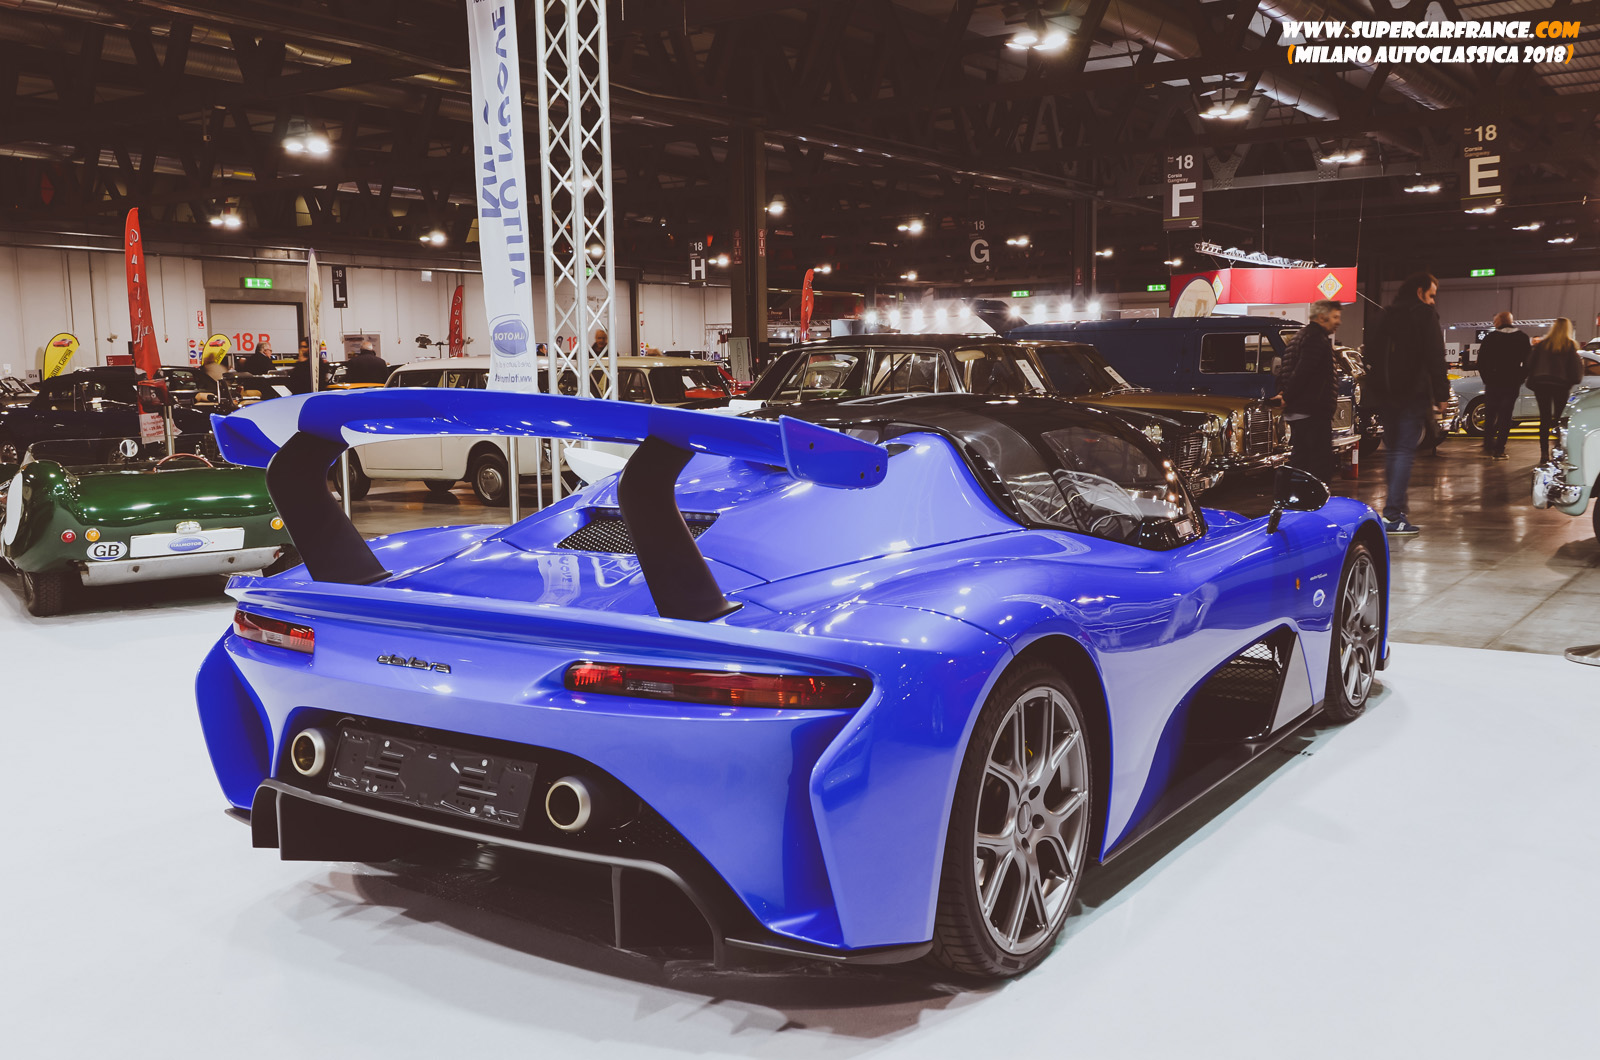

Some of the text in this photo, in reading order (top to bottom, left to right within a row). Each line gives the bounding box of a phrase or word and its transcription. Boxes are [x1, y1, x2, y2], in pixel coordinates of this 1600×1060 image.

[1474, 124, 1498, 142] 18
[1175, 154, 1194, 170] 18
[1469, 155, 1501, 196] E
[1171, 182, 1197, 218] F
[973, 220, 985, 231] 18
[693, 241, 703, 251] 18
[970, 238, 990, 264] G
[335, 269, 343, 278] 18
[691, 258, 706, 280] H
[335, 284, 346, 302] L
[232, 332, 255, 352] 18
[93, 544, 120, 557] GB
